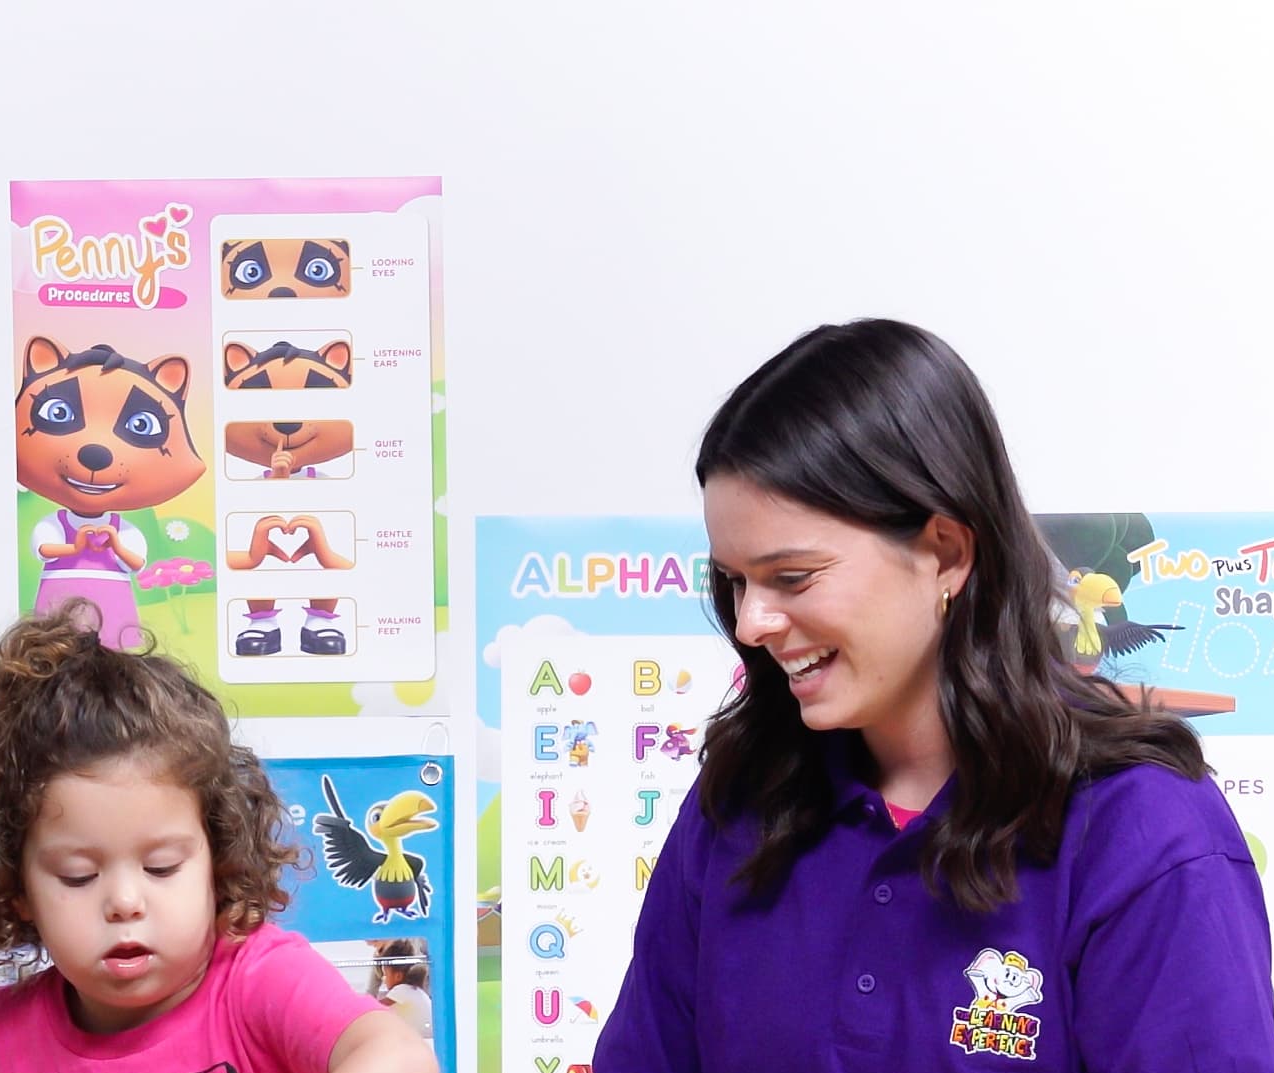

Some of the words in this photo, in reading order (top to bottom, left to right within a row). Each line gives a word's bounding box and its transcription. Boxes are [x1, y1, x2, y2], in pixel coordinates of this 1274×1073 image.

[371, 258, 415, 267] LOOKING
[372, 269, 396, 277] EYES
[47, 286, 131, 304] Procedures
[373, 349, 422, 358] LISTENING
[373, 360, 398, 368] EARS
[375, 440, 404, 448] QUIET
[375, 450, 405, 458] VOICE
[376, 530, 413, 538] GENTLE
[376, 541, 410, 549] HANDS
[1128, 541, 1210, 582] Two
[377, 616, 422, 625] WALKING
[377, 627, 402, 635] FEET
[529, 659, 564, 696] A
[632, 659, 662, 696] B
[536, 705, 557, 716] apple
[534, 725, 559, 761] E
[635, 725, 660, 761] F
[530, 771, 563, 782] elephant
[1224, 779, 1265, 795] PES
[634, 790, 661, 826] J
[530, 855, 564, 891] M
[529, 923, 566, 959] Q
[534, 989, 560, 1025] U
